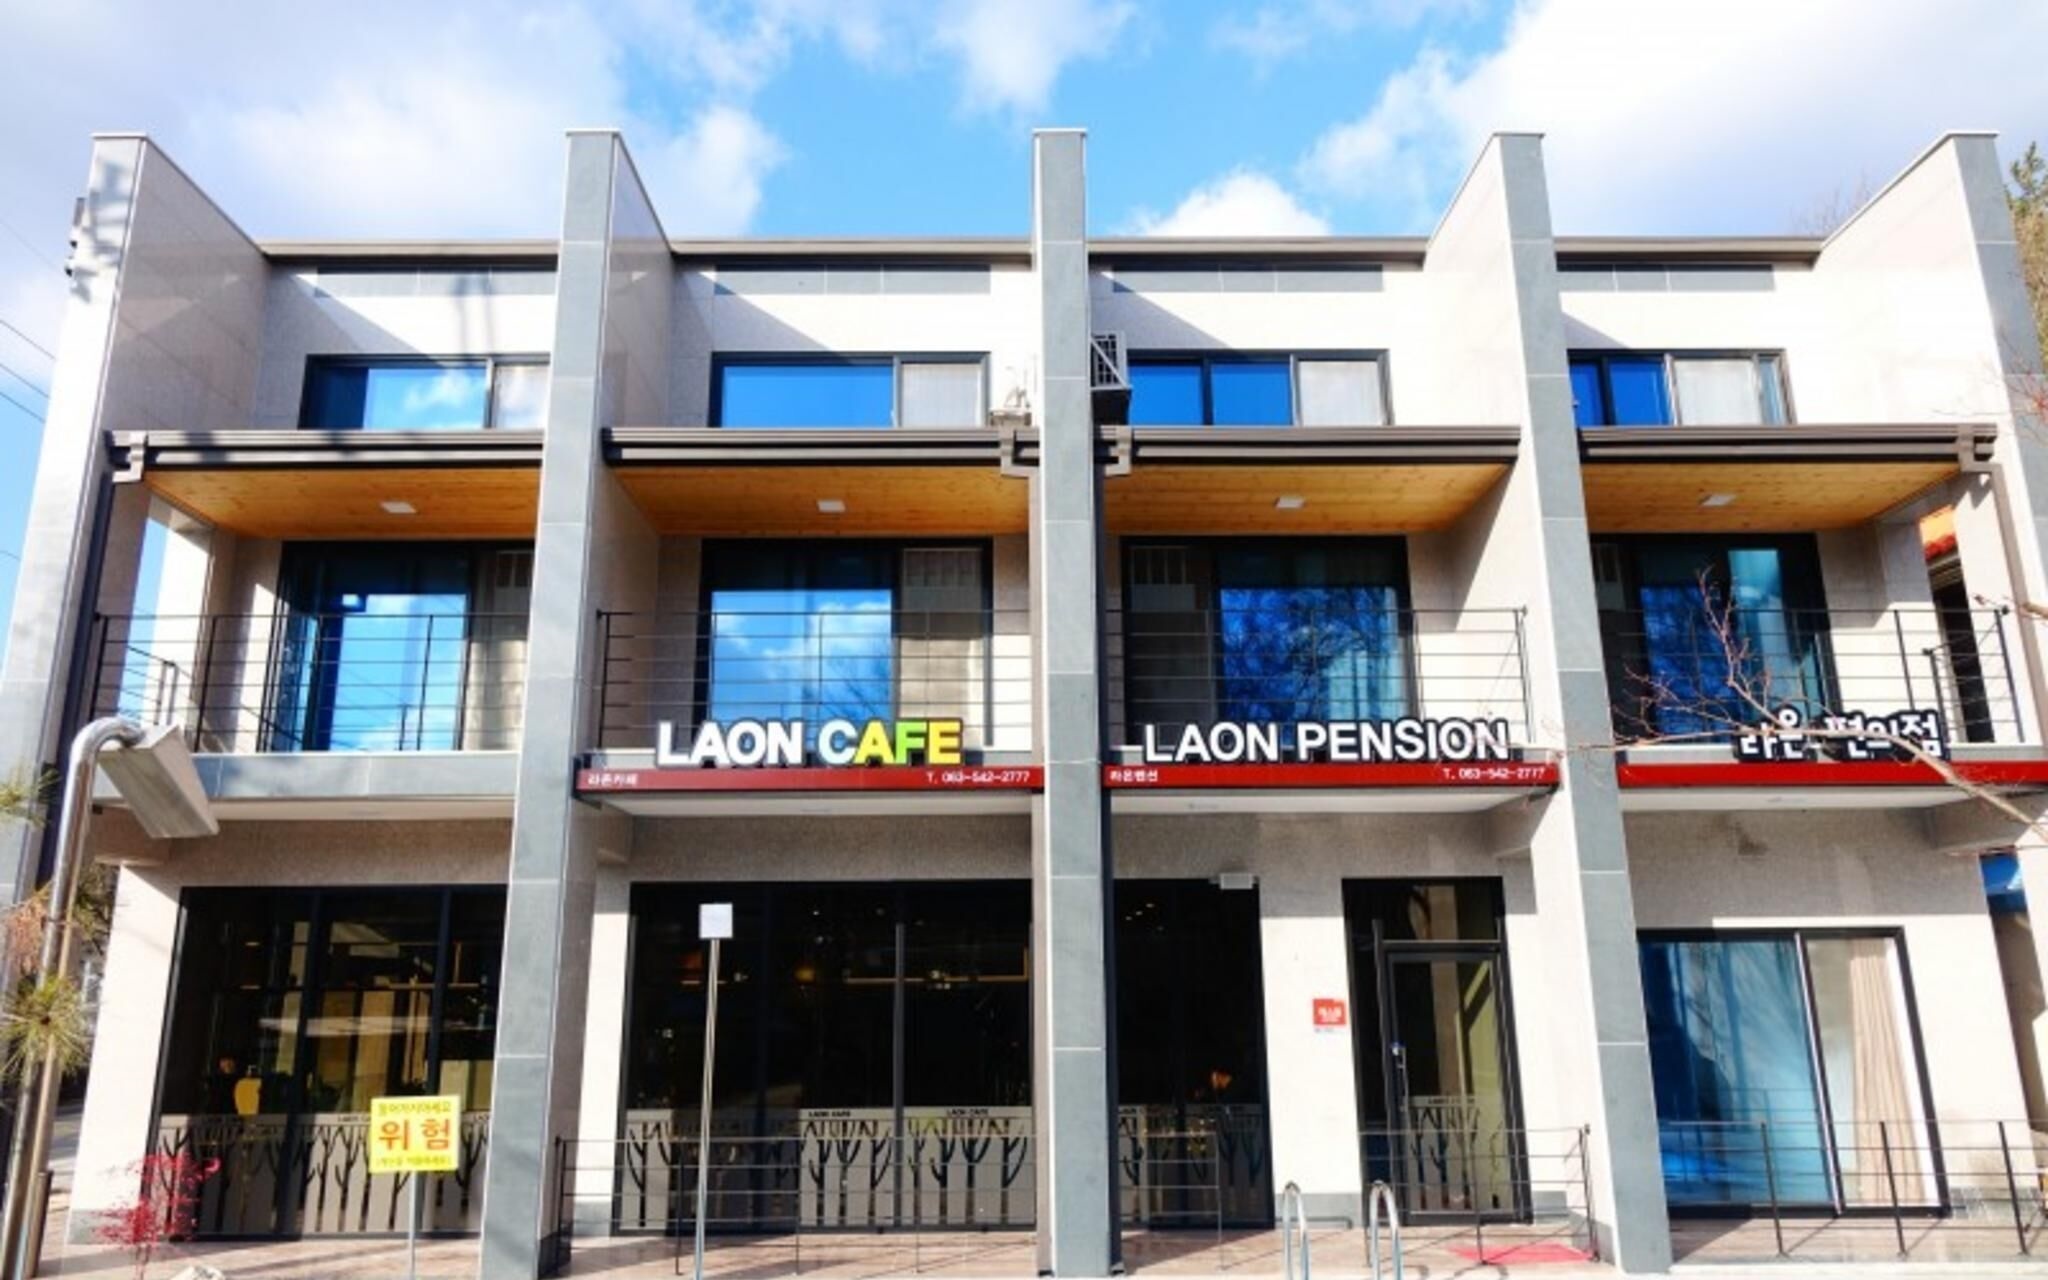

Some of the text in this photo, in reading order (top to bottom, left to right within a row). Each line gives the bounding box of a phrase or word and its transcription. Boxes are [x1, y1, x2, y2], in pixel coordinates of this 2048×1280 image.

[656, 718, 962, 765] LAON CAFE
[1144, 719, 1510, 763] LAON PENSION
[378, 1118, 450, 1151] 위험
